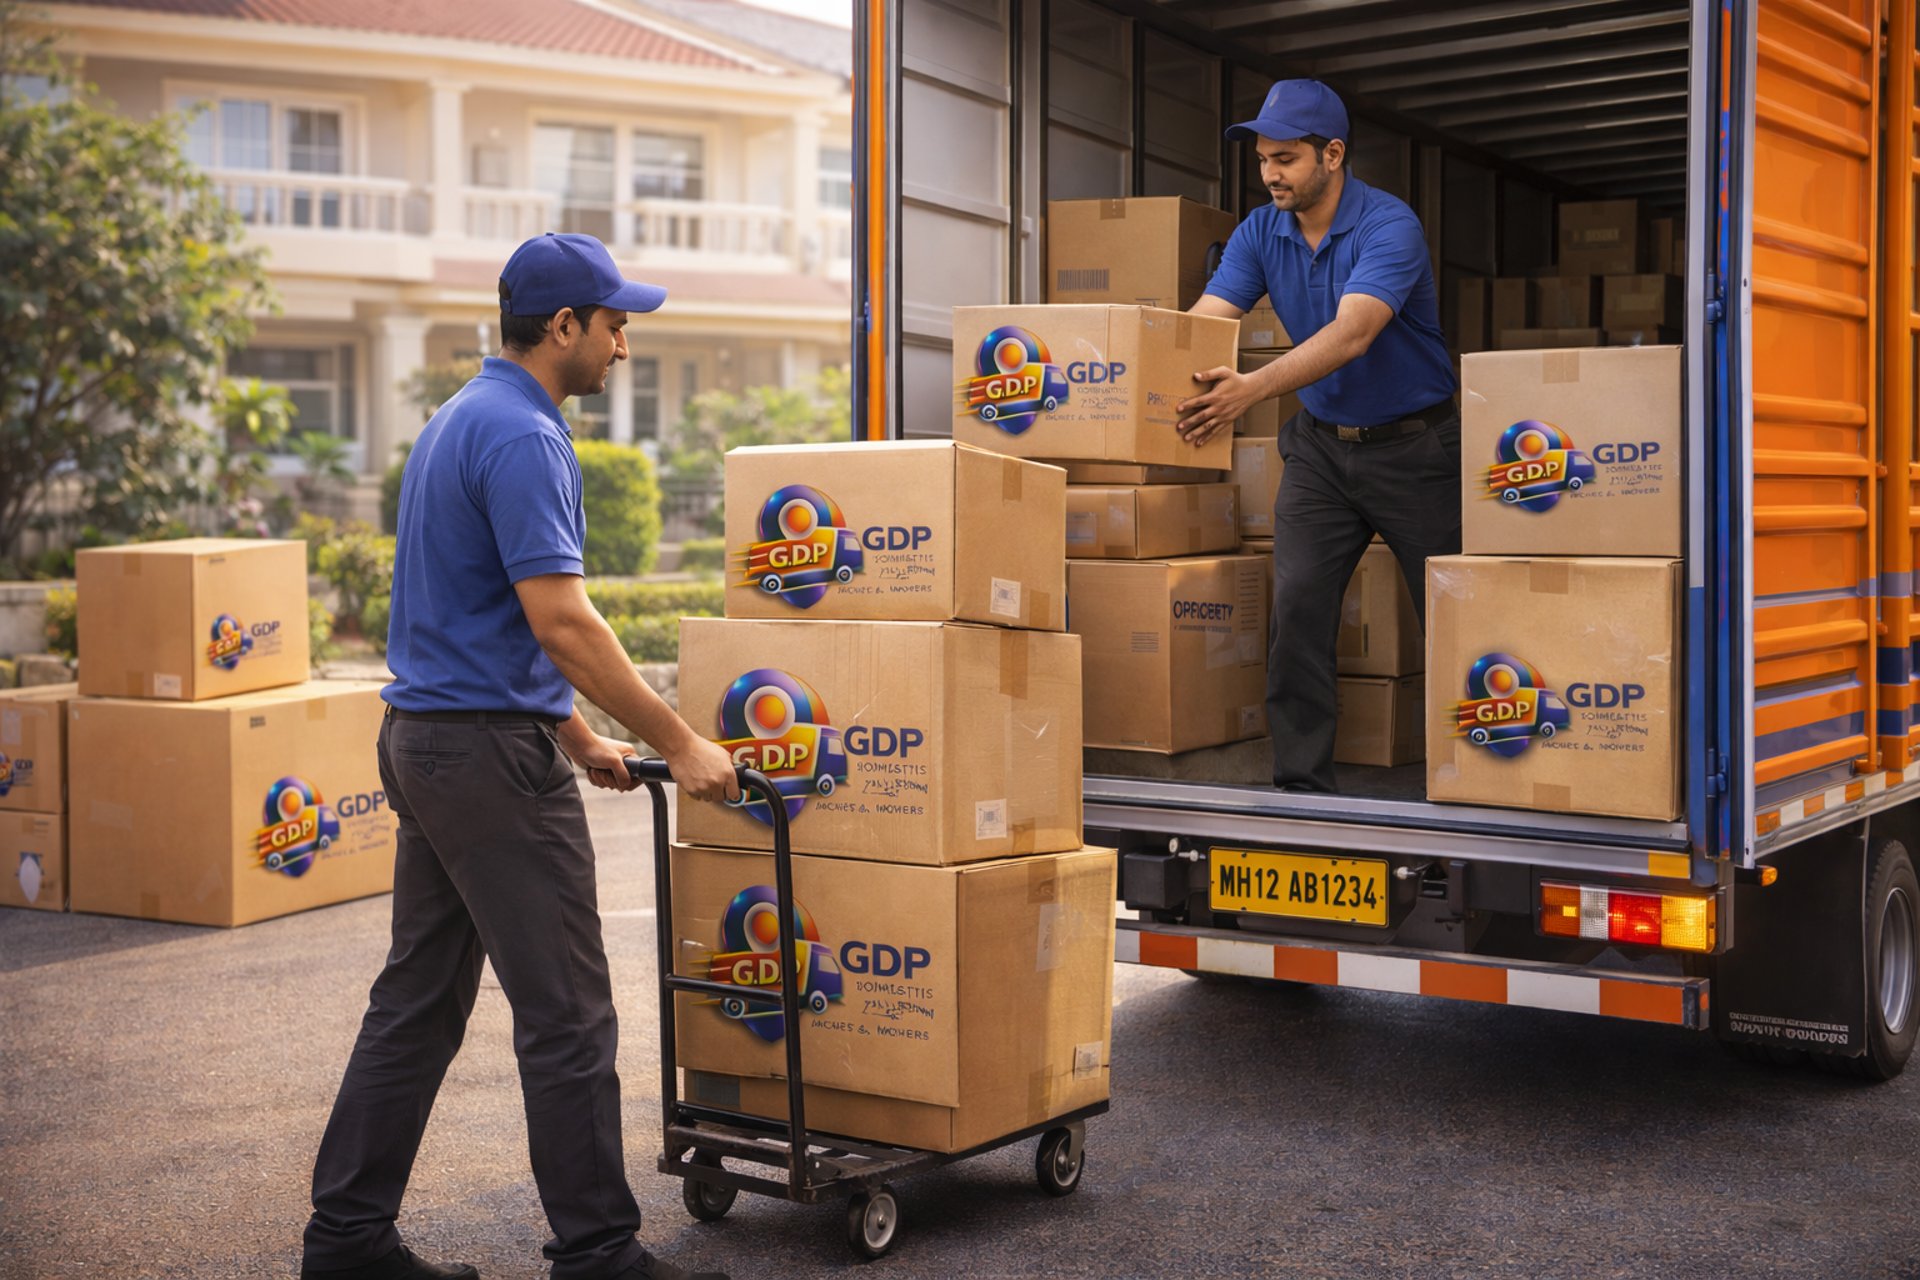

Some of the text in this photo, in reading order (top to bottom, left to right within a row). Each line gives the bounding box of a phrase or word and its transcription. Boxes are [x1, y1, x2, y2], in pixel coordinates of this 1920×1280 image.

[1066, 361, 1126, 384] GDP
[985, 375, 1037, 400] G.D.P
[1592, 441, 1660, 464] GDP
[1506, 461, 1560, 483] G.D.P
[862, 525, 932, 551] GDP
[768, 542, 829, 568] G.D.P
[251, 620, 280, 637] GDP
[1566, 682, 1645, 709] GDP
[1475, 700, 1530, 722] G.D.P
[844, 725, 924, 758] GDP
[732, 743, 809, 771] G.D.P
[337, 790, 386, 818] GDP
[1219, 864, 1377, 909] MH12 AB1234
[732, 957, 801, 986] G.D.
[840, 940, 931, 979] GDP
